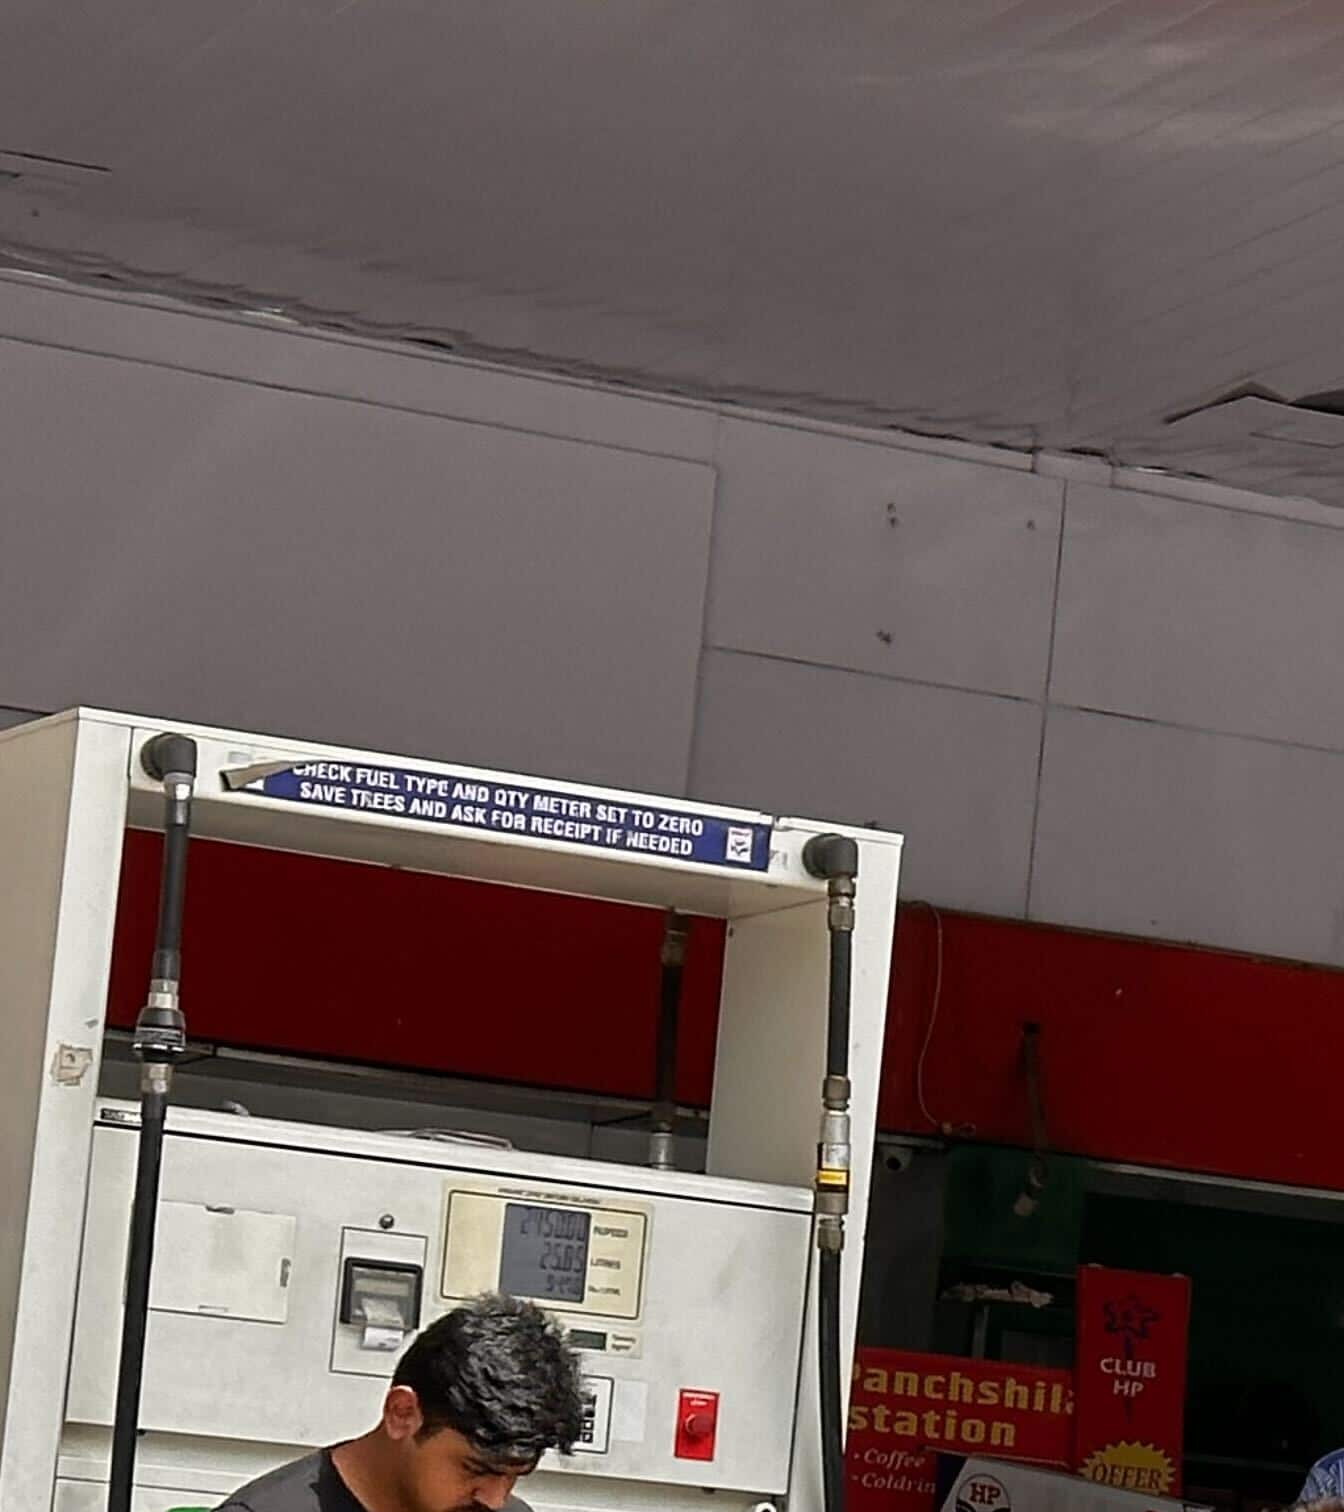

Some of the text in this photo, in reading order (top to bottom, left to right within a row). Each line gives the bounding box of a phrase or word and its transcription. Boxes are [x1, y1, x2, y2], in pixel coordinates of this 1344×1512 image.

[356, 768, 400, 789] FUEL
[404, 774, 449, 796] TYPE
[450, 783, 490, 801] AND
[495, 789, 529, 809] QTY
[533, 795, 591, 819] METER
[596, 804, 628, 824] SET
[632, 809, 655, 829] TO
[659, 814, 704, 836] ZERO
[300, 781, 693, 856] SAVE TREES AND ASK FOR RECEIPT IF NEEDED
[1099, 1357, 1157, 1378] CLUB
[852, 1363, 1075, 1416] anchshil
[1113, 1379, 1145, 1398] HP
[849, 1403, 1017, 1448] station
[863, 1449, 927, 1471] Coffee
[1091, 1463, 1163, 1490] OFFER
[969, 1481, 1002, 1506] HP
